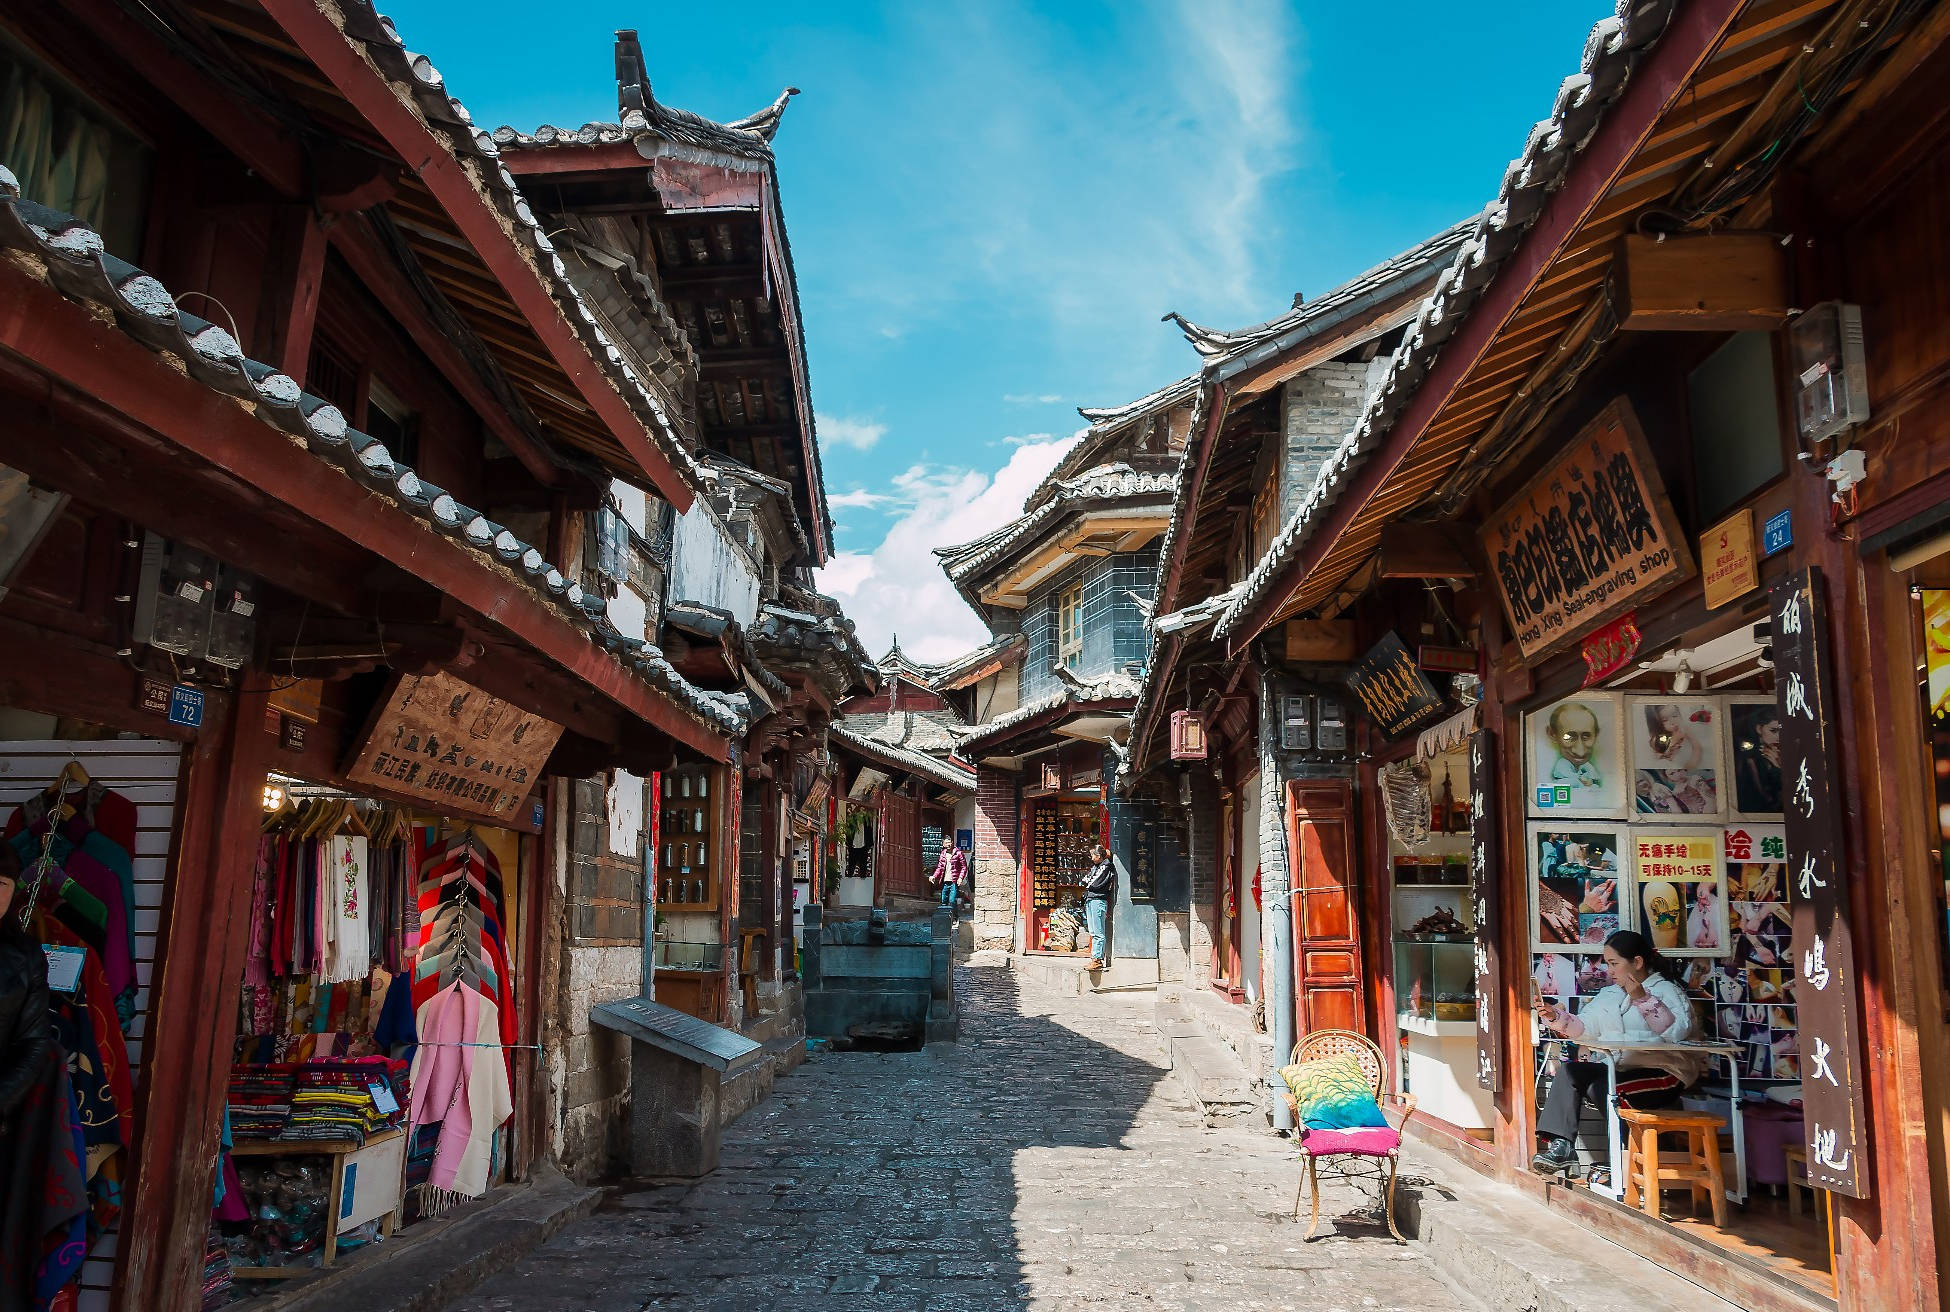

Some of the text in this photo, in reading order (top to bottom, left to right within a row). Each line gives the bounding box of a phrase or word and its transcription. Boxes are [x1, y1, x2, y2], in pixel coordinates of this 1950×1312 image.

[1772, 530, 1783, 547] 24
[1519, 548, 1670, 647] Hong Xing Seal-engraving shop
[182, 704, 195, 721] 72
[1638, 843, 1689, 859] 无痛手绘
[1725, 829, 1785, 860] 绘 纯
[1641, 864, 1712, 877] 可保持10-15天
